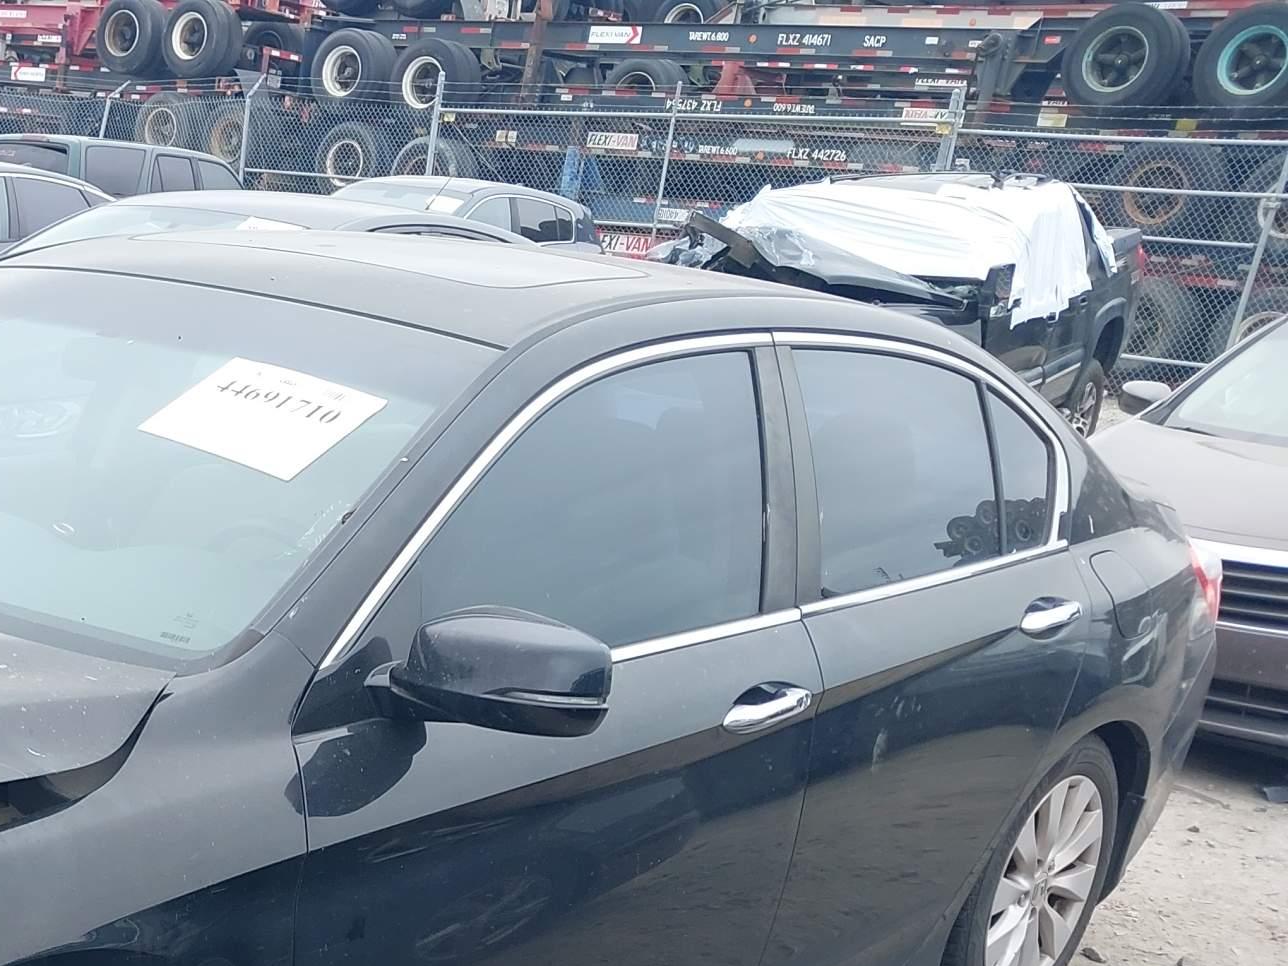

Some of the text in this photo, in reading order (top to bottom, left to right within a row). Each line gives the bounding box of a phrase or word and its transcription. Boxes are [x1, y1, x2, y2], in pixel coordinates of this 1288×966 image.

[777, 33, 832, 48] FLXZ 414671
[863, 35, 887, 48] SACP
[588, 133, 638, 149] FLEXI-VAN
[811, 149, 847, 162] 442726
[217, 380, 342, 424] 44691710
